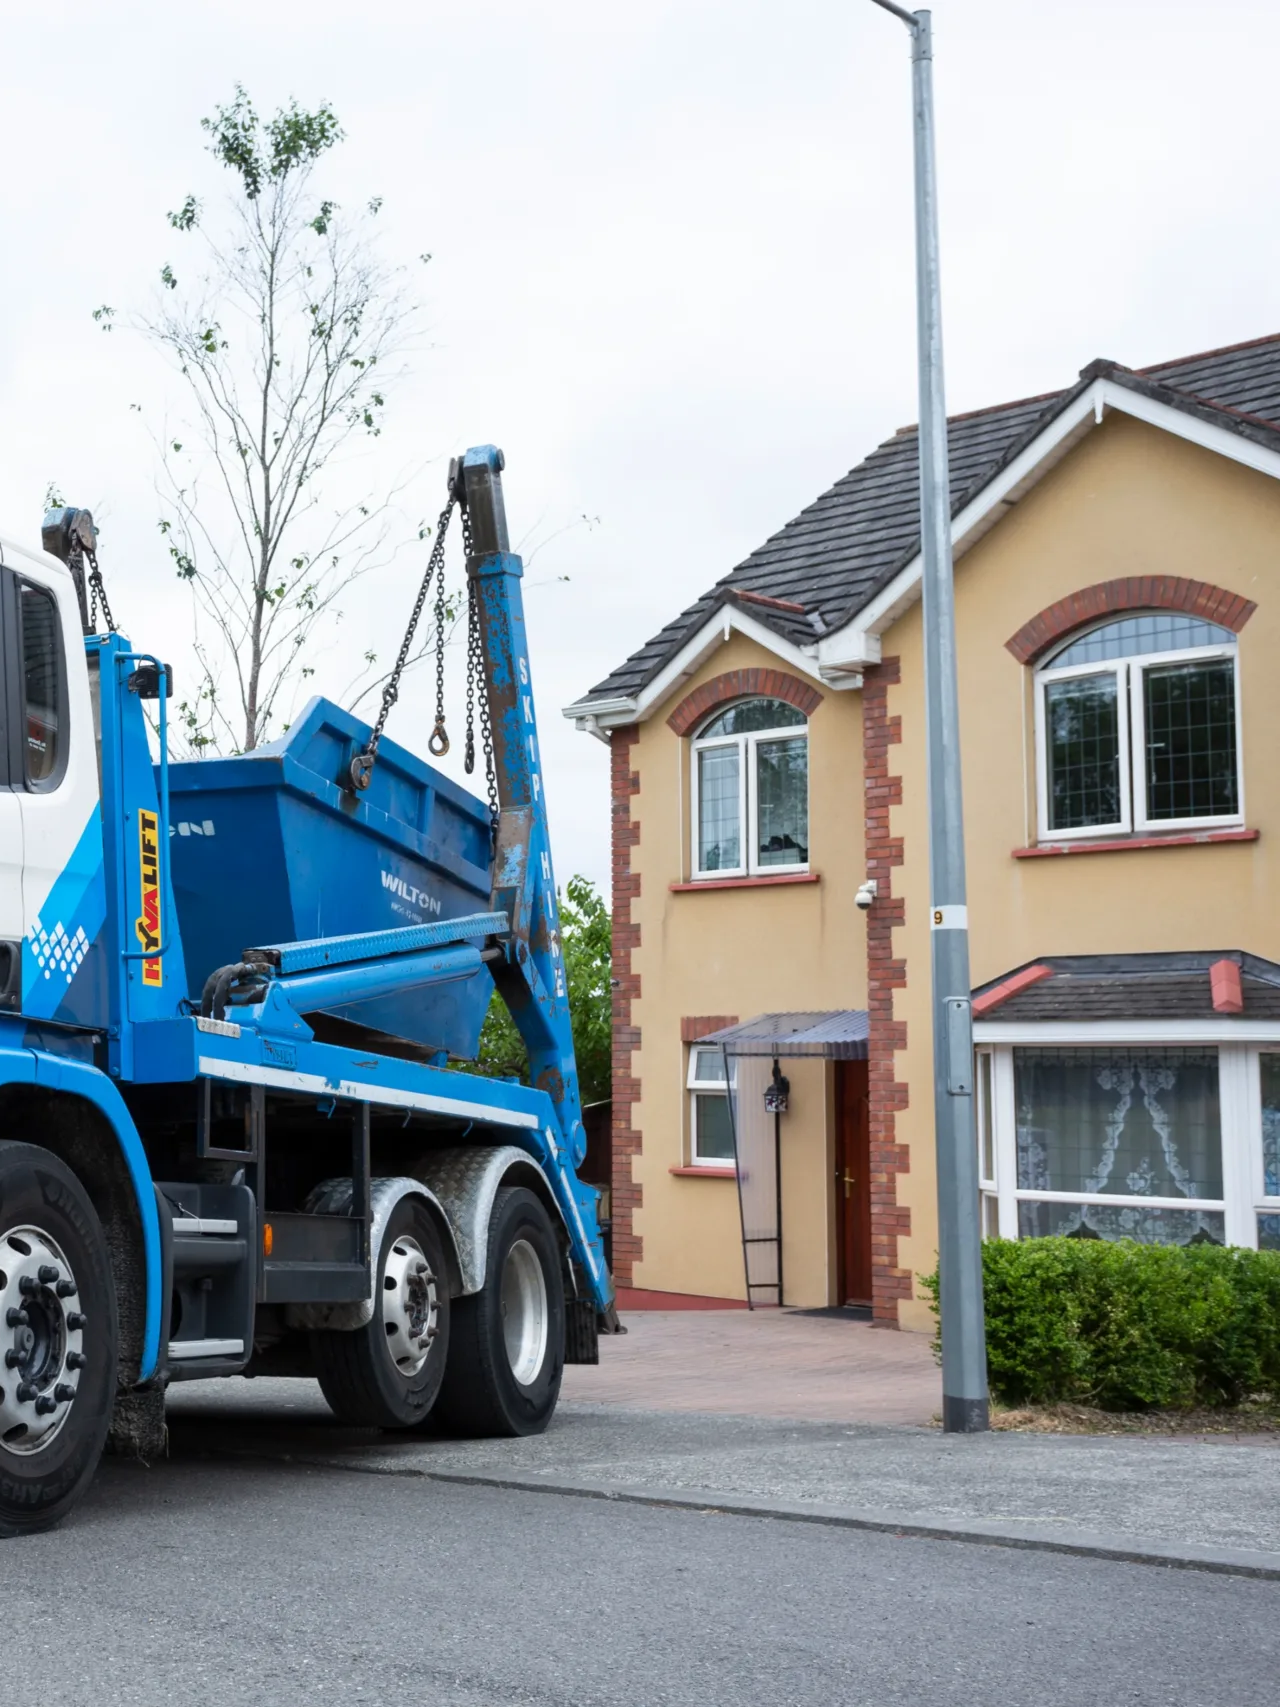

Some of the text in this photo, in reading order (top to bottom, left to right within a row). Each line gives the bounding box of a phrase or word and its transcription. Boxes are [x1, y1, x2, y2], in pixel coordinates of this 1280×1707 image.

[519, 657, 565, 998] SKIP HIRE
[381, 869, 441, 916] WILTON
[933, 911, 943, 925] 9
